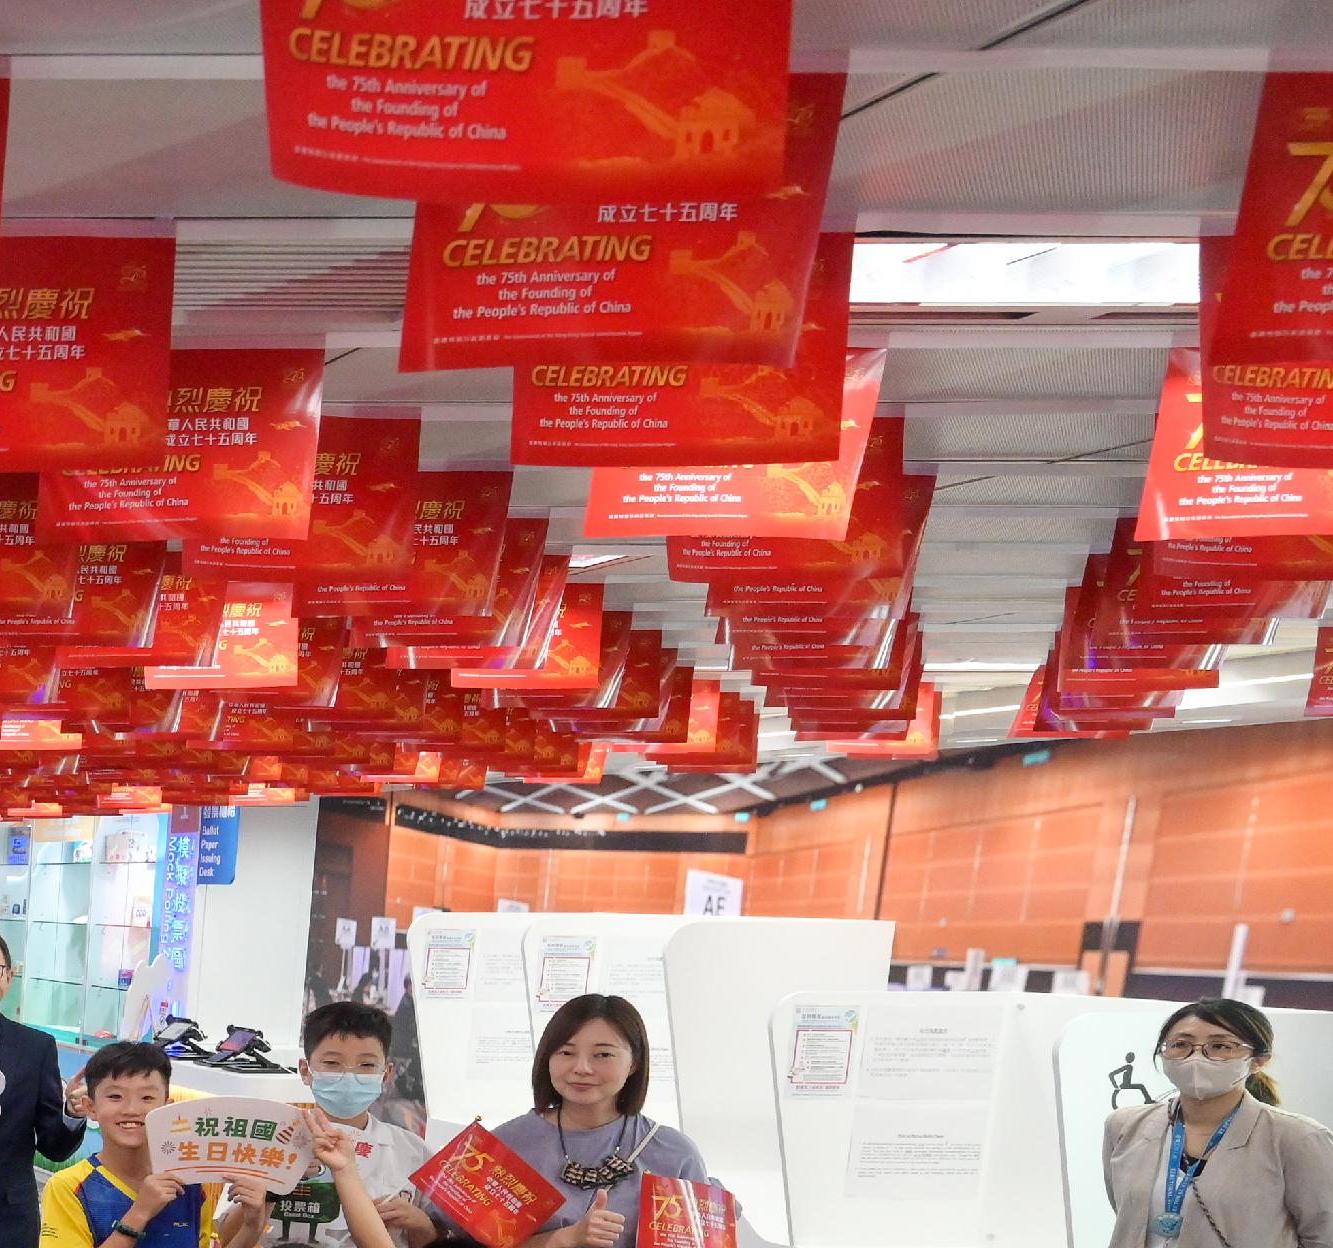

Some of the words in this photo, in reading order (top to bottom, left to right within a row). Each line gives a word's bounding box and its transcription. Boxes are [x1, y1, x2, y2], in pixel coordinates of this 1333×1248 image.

[289, 27, 533, 71] CELEBRATING
[597, 203, 737, 223] 成立七十五周年
[443, 234, 652, 268] CELEBRATING
[167, 837, 176, 881] Mock
[201, 840, 218, 850] Paper
[161, 889, 174, 944] Polling
[195, 1116, 278, 1141] 祝祖國
[177, 1141, 298, 1169] 生日快樂!
